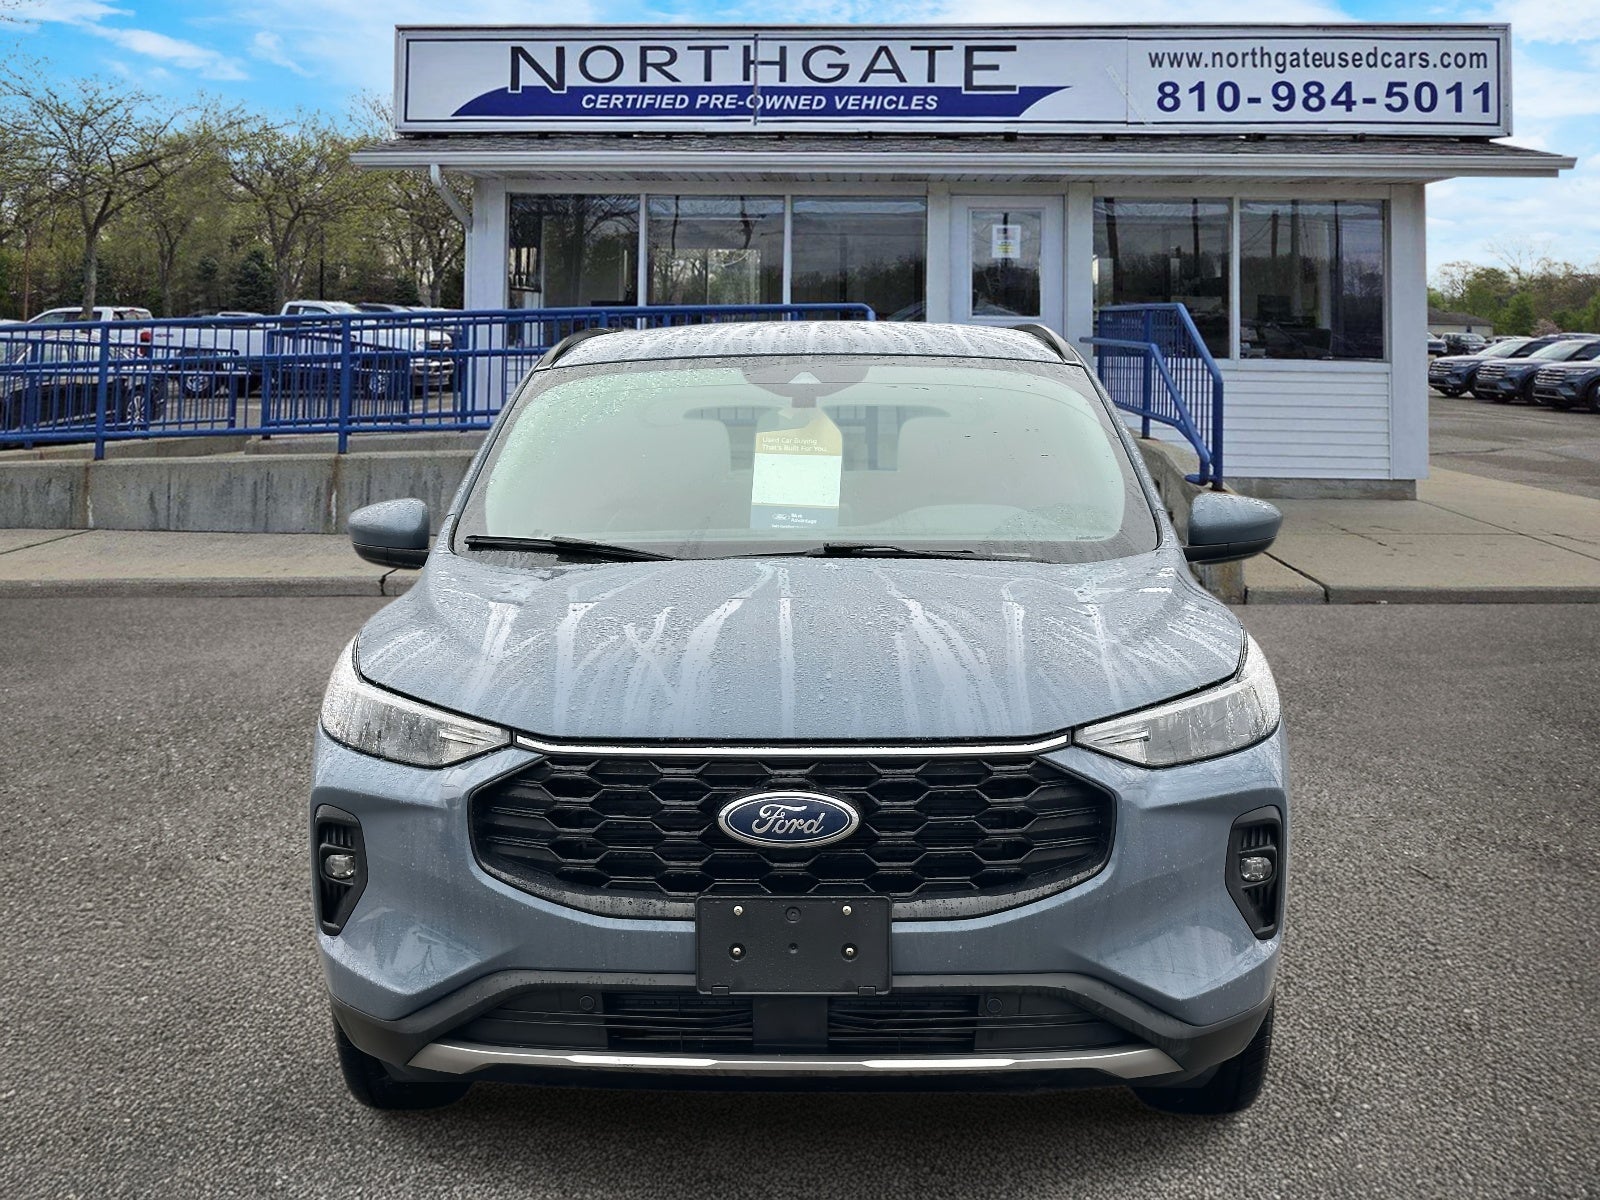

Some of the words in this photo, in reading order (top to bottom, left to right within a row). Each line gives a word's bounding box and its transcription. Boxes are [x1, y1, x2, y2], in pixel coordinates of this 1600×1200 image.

[509, 44, 1018, 93] NORTHGATE
[1148, 46, 1489, 74] www.northgateusedcars.com
[581, 94, 690, 110] CERTIFIED
[695, 94, 826, 111] PRE-OWNED
[834, 94, 938, 111] VEHICLES
[1156, 80, 1491, 114] 810-984-5011
[751, 803, 826, 834] Ford
